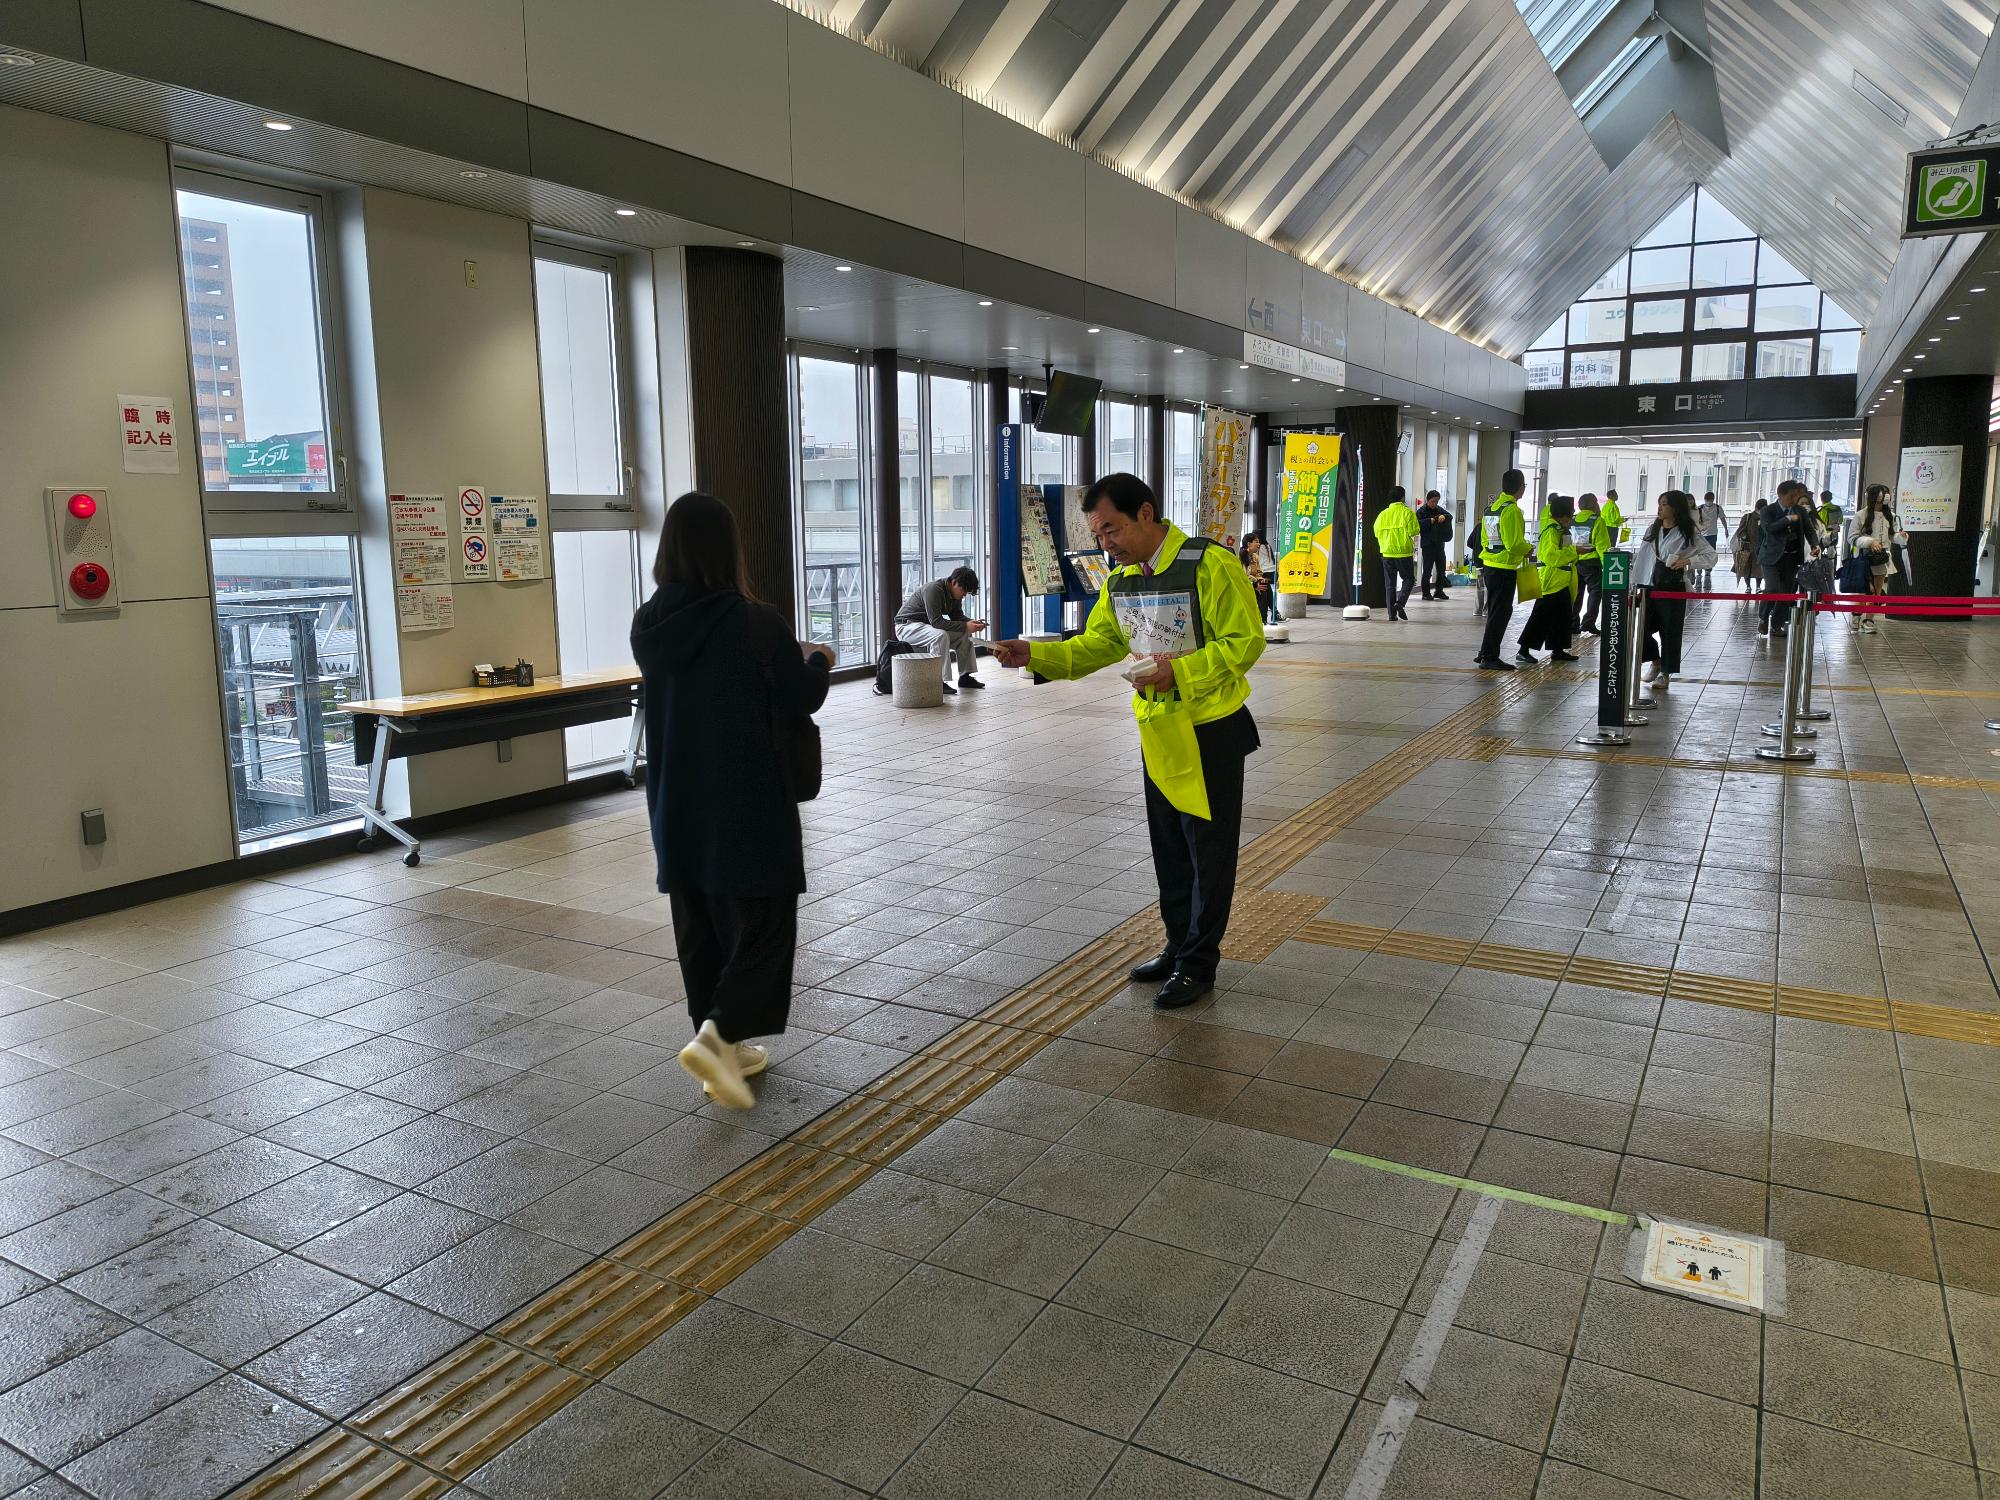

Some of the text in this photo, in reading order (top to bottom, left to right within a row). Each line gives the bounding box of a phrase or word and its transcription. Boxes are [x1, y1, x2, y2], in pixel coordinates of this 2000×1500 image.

[1930, 164, 1976, 177] みどりの窓口
[126, 430, 173, 446] 記入台
[242, 443, 290, 468] エイブル
[1003, 438, 1011, 480] Information
[1294, 471, 1319, 553] 納貯の日
[1317, 472, 1331, 527] 4月10日は
[465, 517, 482, 526] 禁煙
[1608, 556, 1624, 585] 入口
[1606, 594, 1620, 699] こちらからお入りください。
